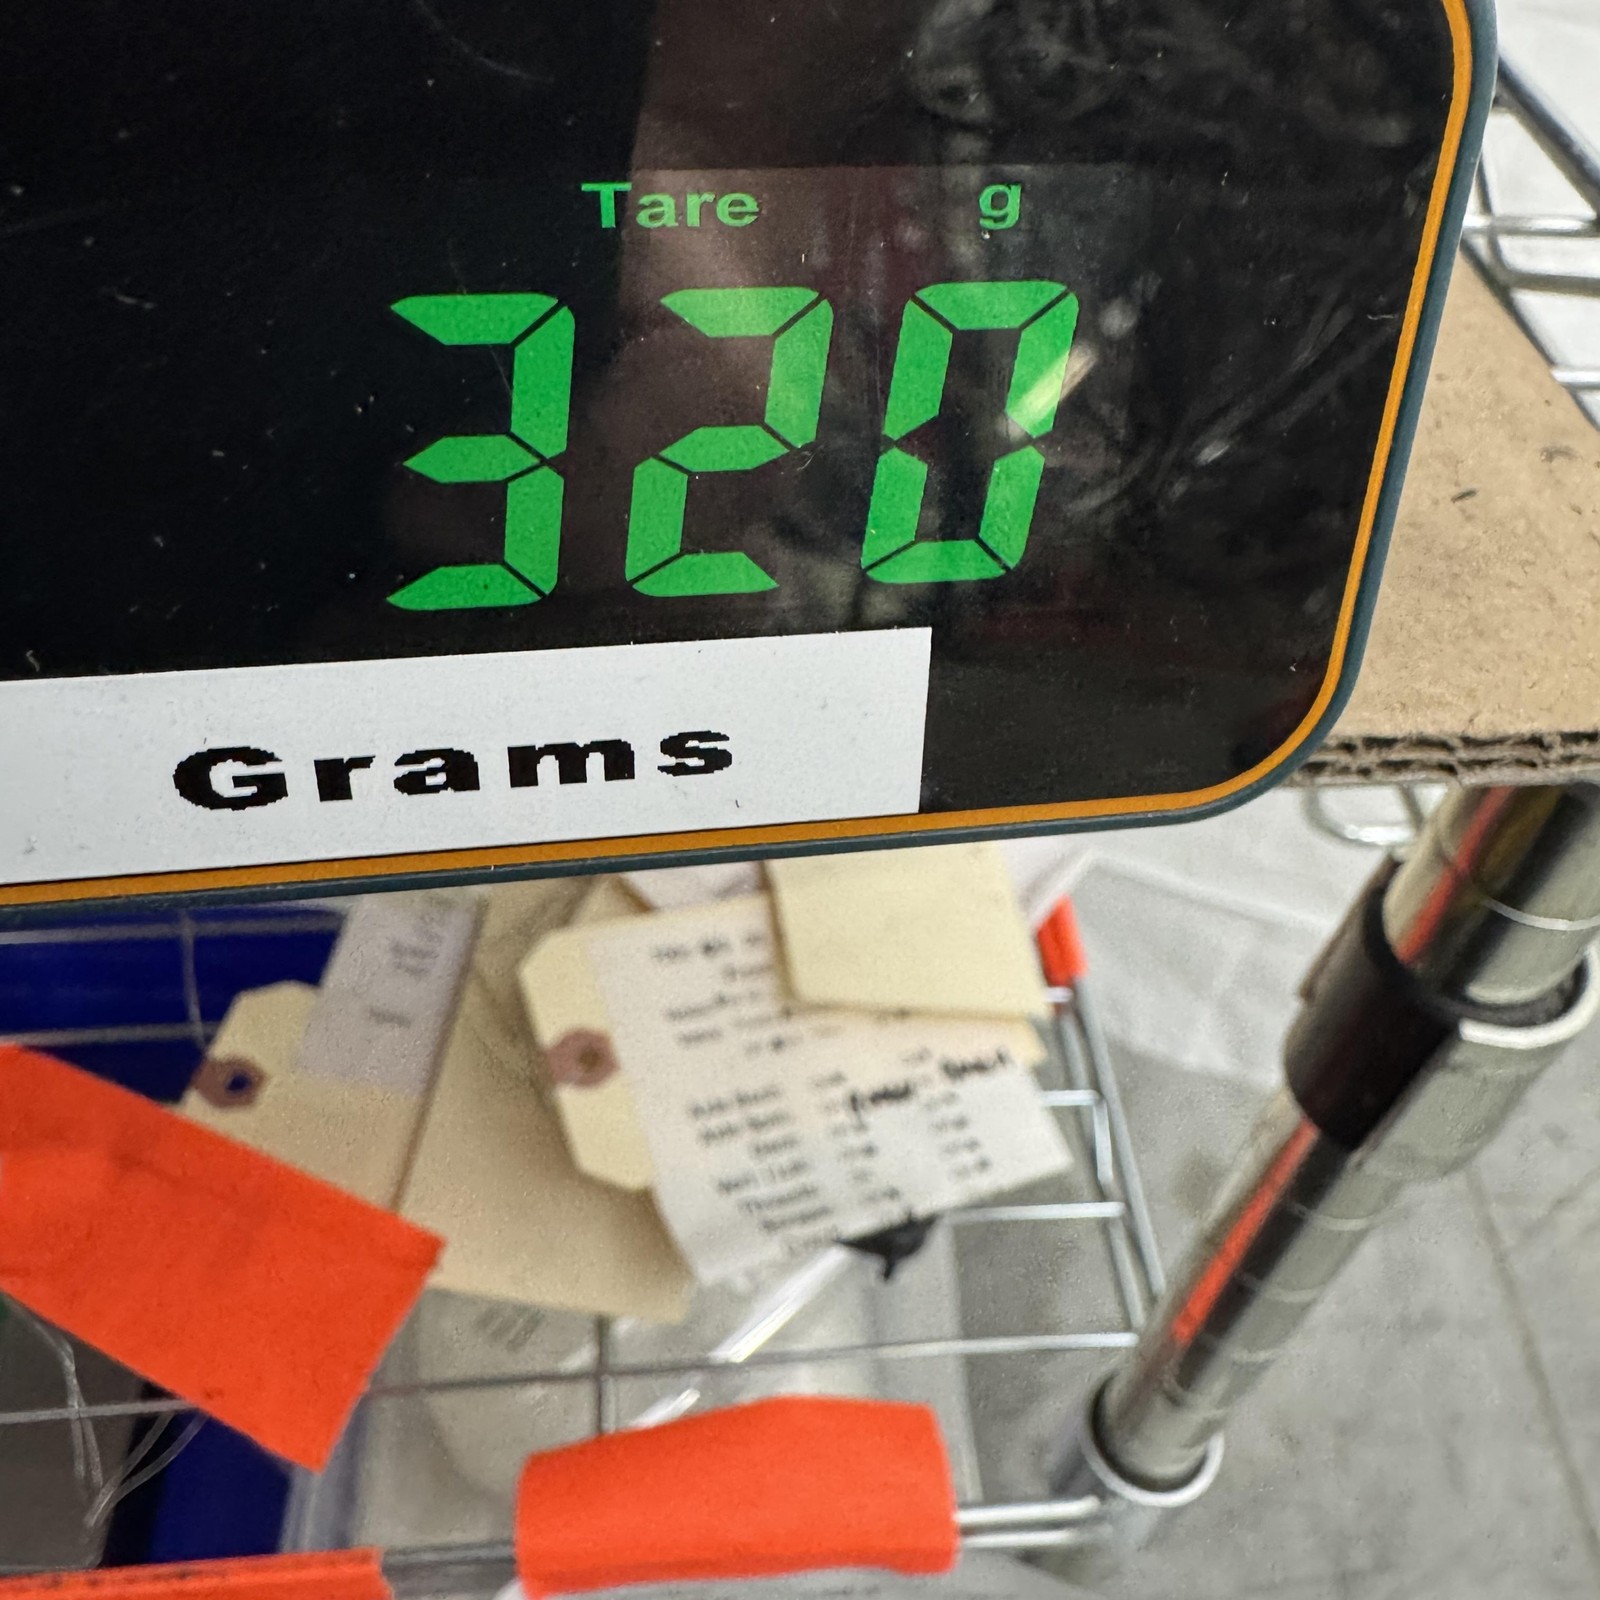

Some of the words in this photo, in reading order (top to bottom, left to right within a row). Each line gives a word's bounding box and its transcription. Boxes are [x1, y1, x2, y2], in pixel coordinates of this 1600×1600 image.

[581, 182, 761, 230] Tare
[979, 183, 1022, 230] g
[387, 280, 1080, 611] 320
[172, 730, 734, 812] Grams
